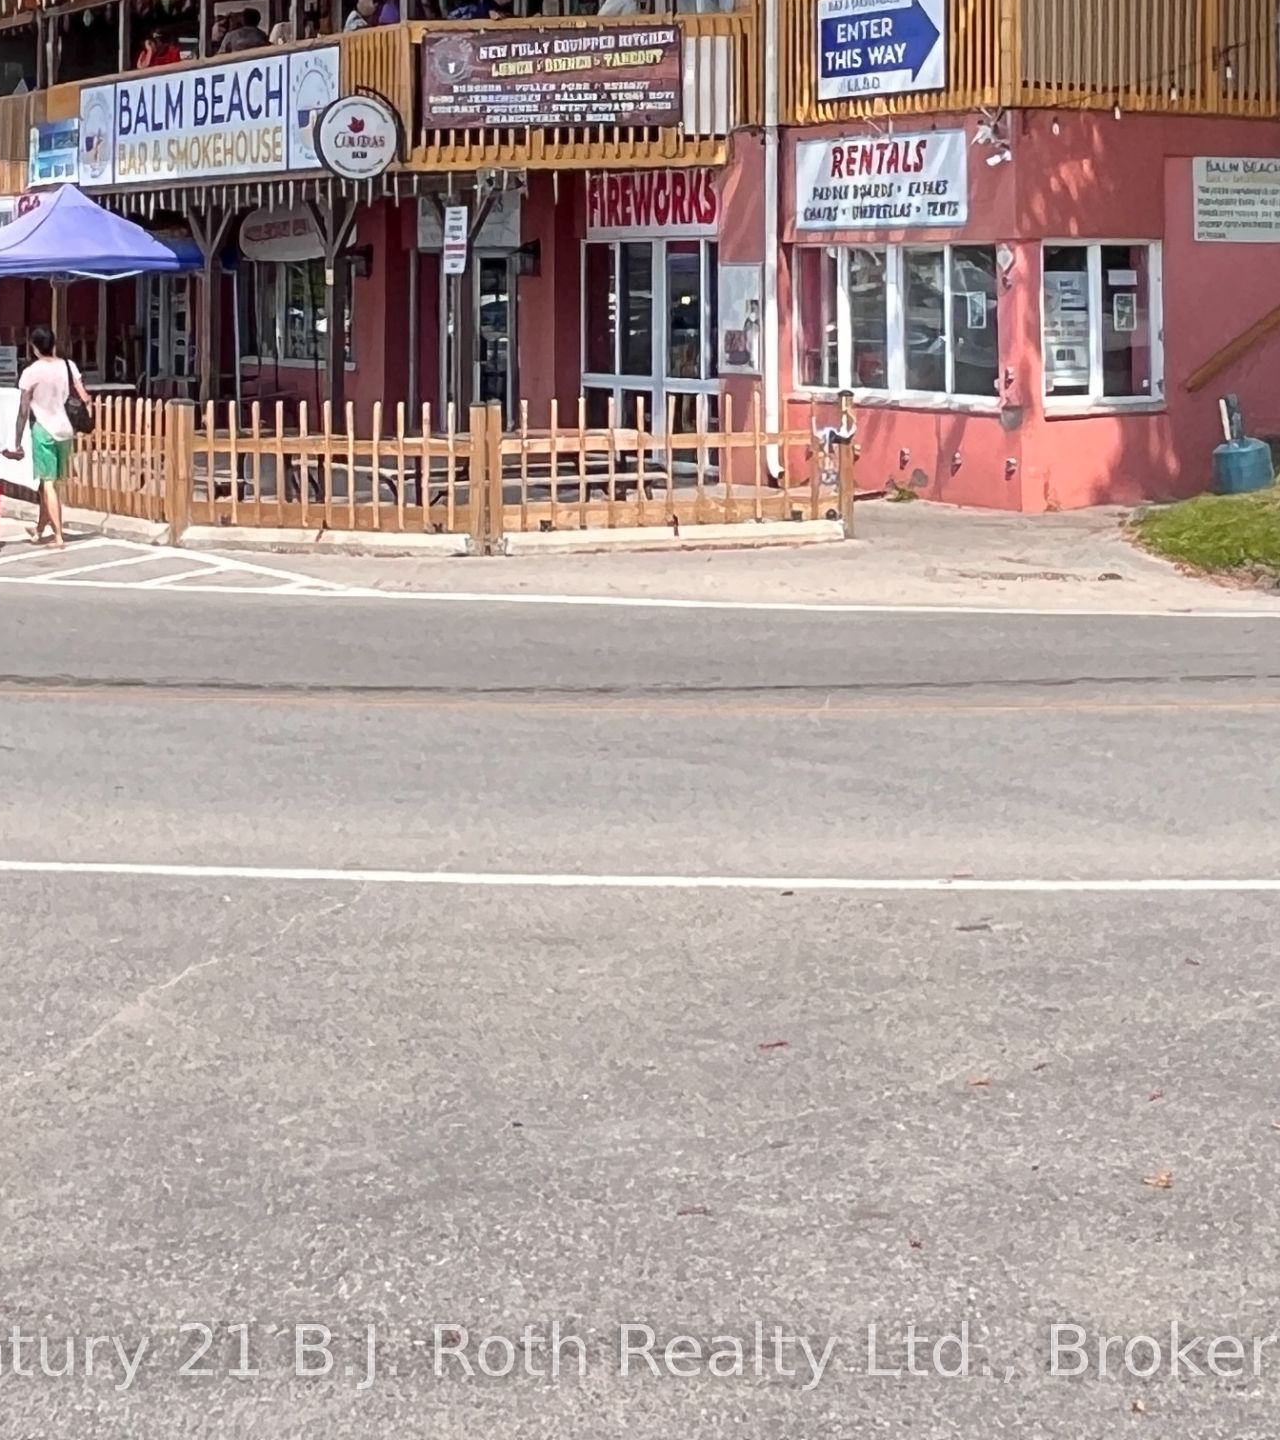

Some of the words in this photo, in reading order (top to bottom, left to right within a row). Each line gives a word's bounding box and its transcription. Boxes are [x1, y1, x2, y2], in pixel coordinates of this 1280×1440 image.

[479, 45, 507, 59] NEW
[511, 41, 551, 57] FULLY
[837, 17, 893, 43] ENTER
[825, 48, 862, 71] THIS
[867, 42, 907, 66] WAY
[118, 78, 184, 136] BALM
[193, 63, 284, 128] BEACH
[118, 140, 148, 176] BAR
[152, 139, 162, 172] &
[166, 125, 283, 173] SMOKEHOUSE
[831, 139, 927, 179] RENTALS
[588, 168, 716, 228] FIREWORKS
